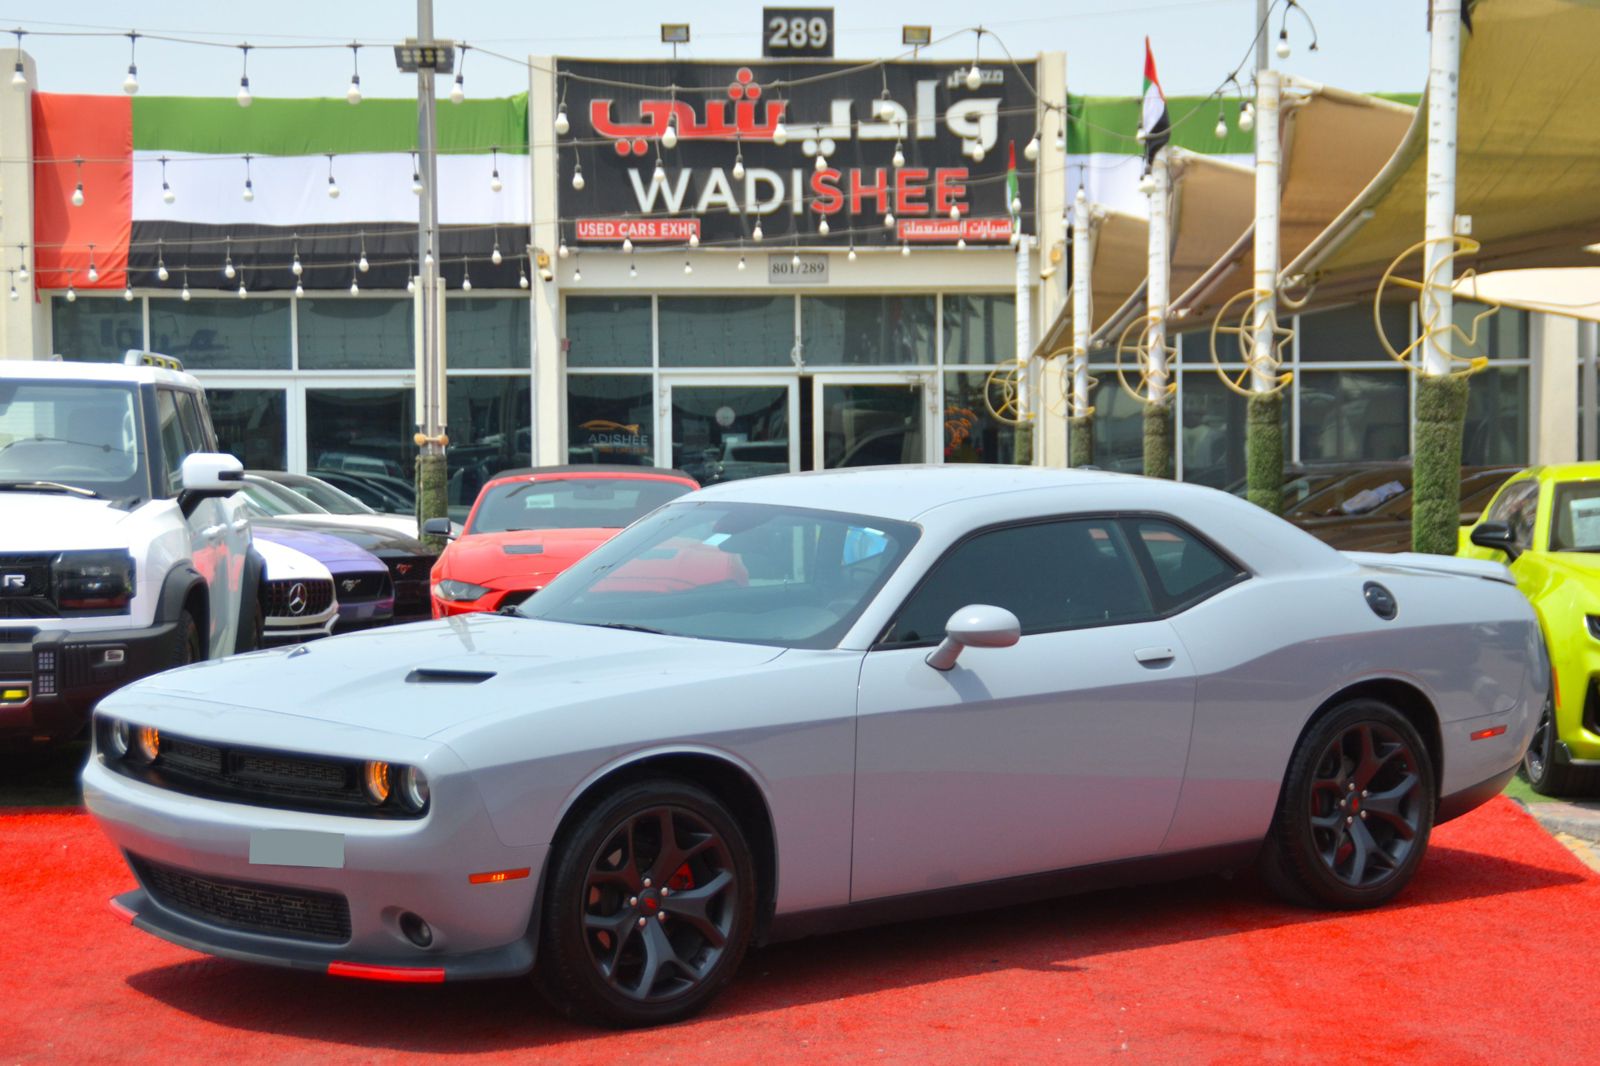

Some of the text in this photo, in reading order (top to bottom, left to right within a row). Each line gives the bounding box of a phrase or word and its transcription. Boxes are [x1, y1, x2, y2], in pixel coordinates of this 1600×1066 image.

[768, 16, 828, 48] 289
[627, 167, 969, 214] WADISHEE
[578, 222, 615, 236] USED
[618, 222, 656, 236] CARS
